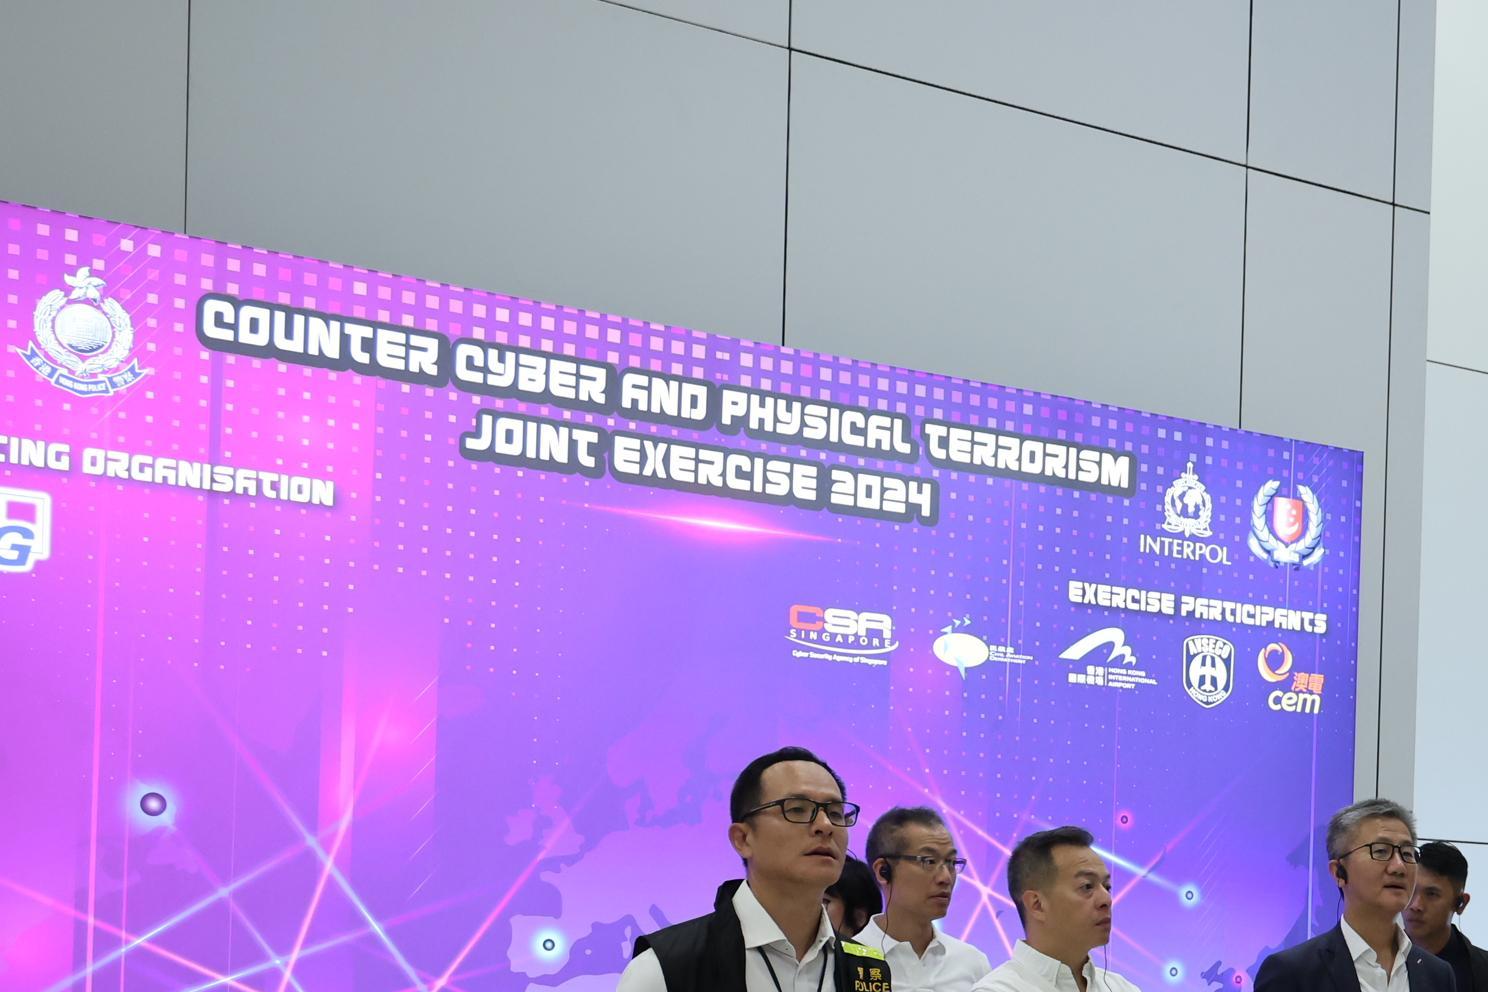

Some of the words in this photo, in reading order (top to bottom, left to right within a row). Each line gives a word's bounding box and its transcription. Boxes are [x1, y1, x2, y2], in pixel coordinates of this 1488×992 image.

[203, 299, 439, 376] COUNTER
[455, 343, 606, 405] CYBER
[621, 372, 708, 421] AND
[721, 389, 912, 455] PHYSICAL
[925, 422, 1130, 489] TERRORISM
[82, 446, 335, 507] ORGANISATION
[465, 413, 599, 469] JOINT
[614, 435, 819, 501] EXERCISE
[830, 469, 932, 517] 2024
[1139, 534, 1232, 566] INTERPOL
[789, 604, 893, 639] CSA
[1068, 580, 1175, 616] EXERCISE
[1180, 595, 1328, 634] PARTICIPANTS
[789, 629, 892, 648] SINGAPORE
[1188, 637, 1231, 660] AVSECO
[1107, 681, 1136, 689] AIRPORT
[1108, 674, 1158, 685] INTERNATIONAL
[1268, 690, 1321, 714] cem
